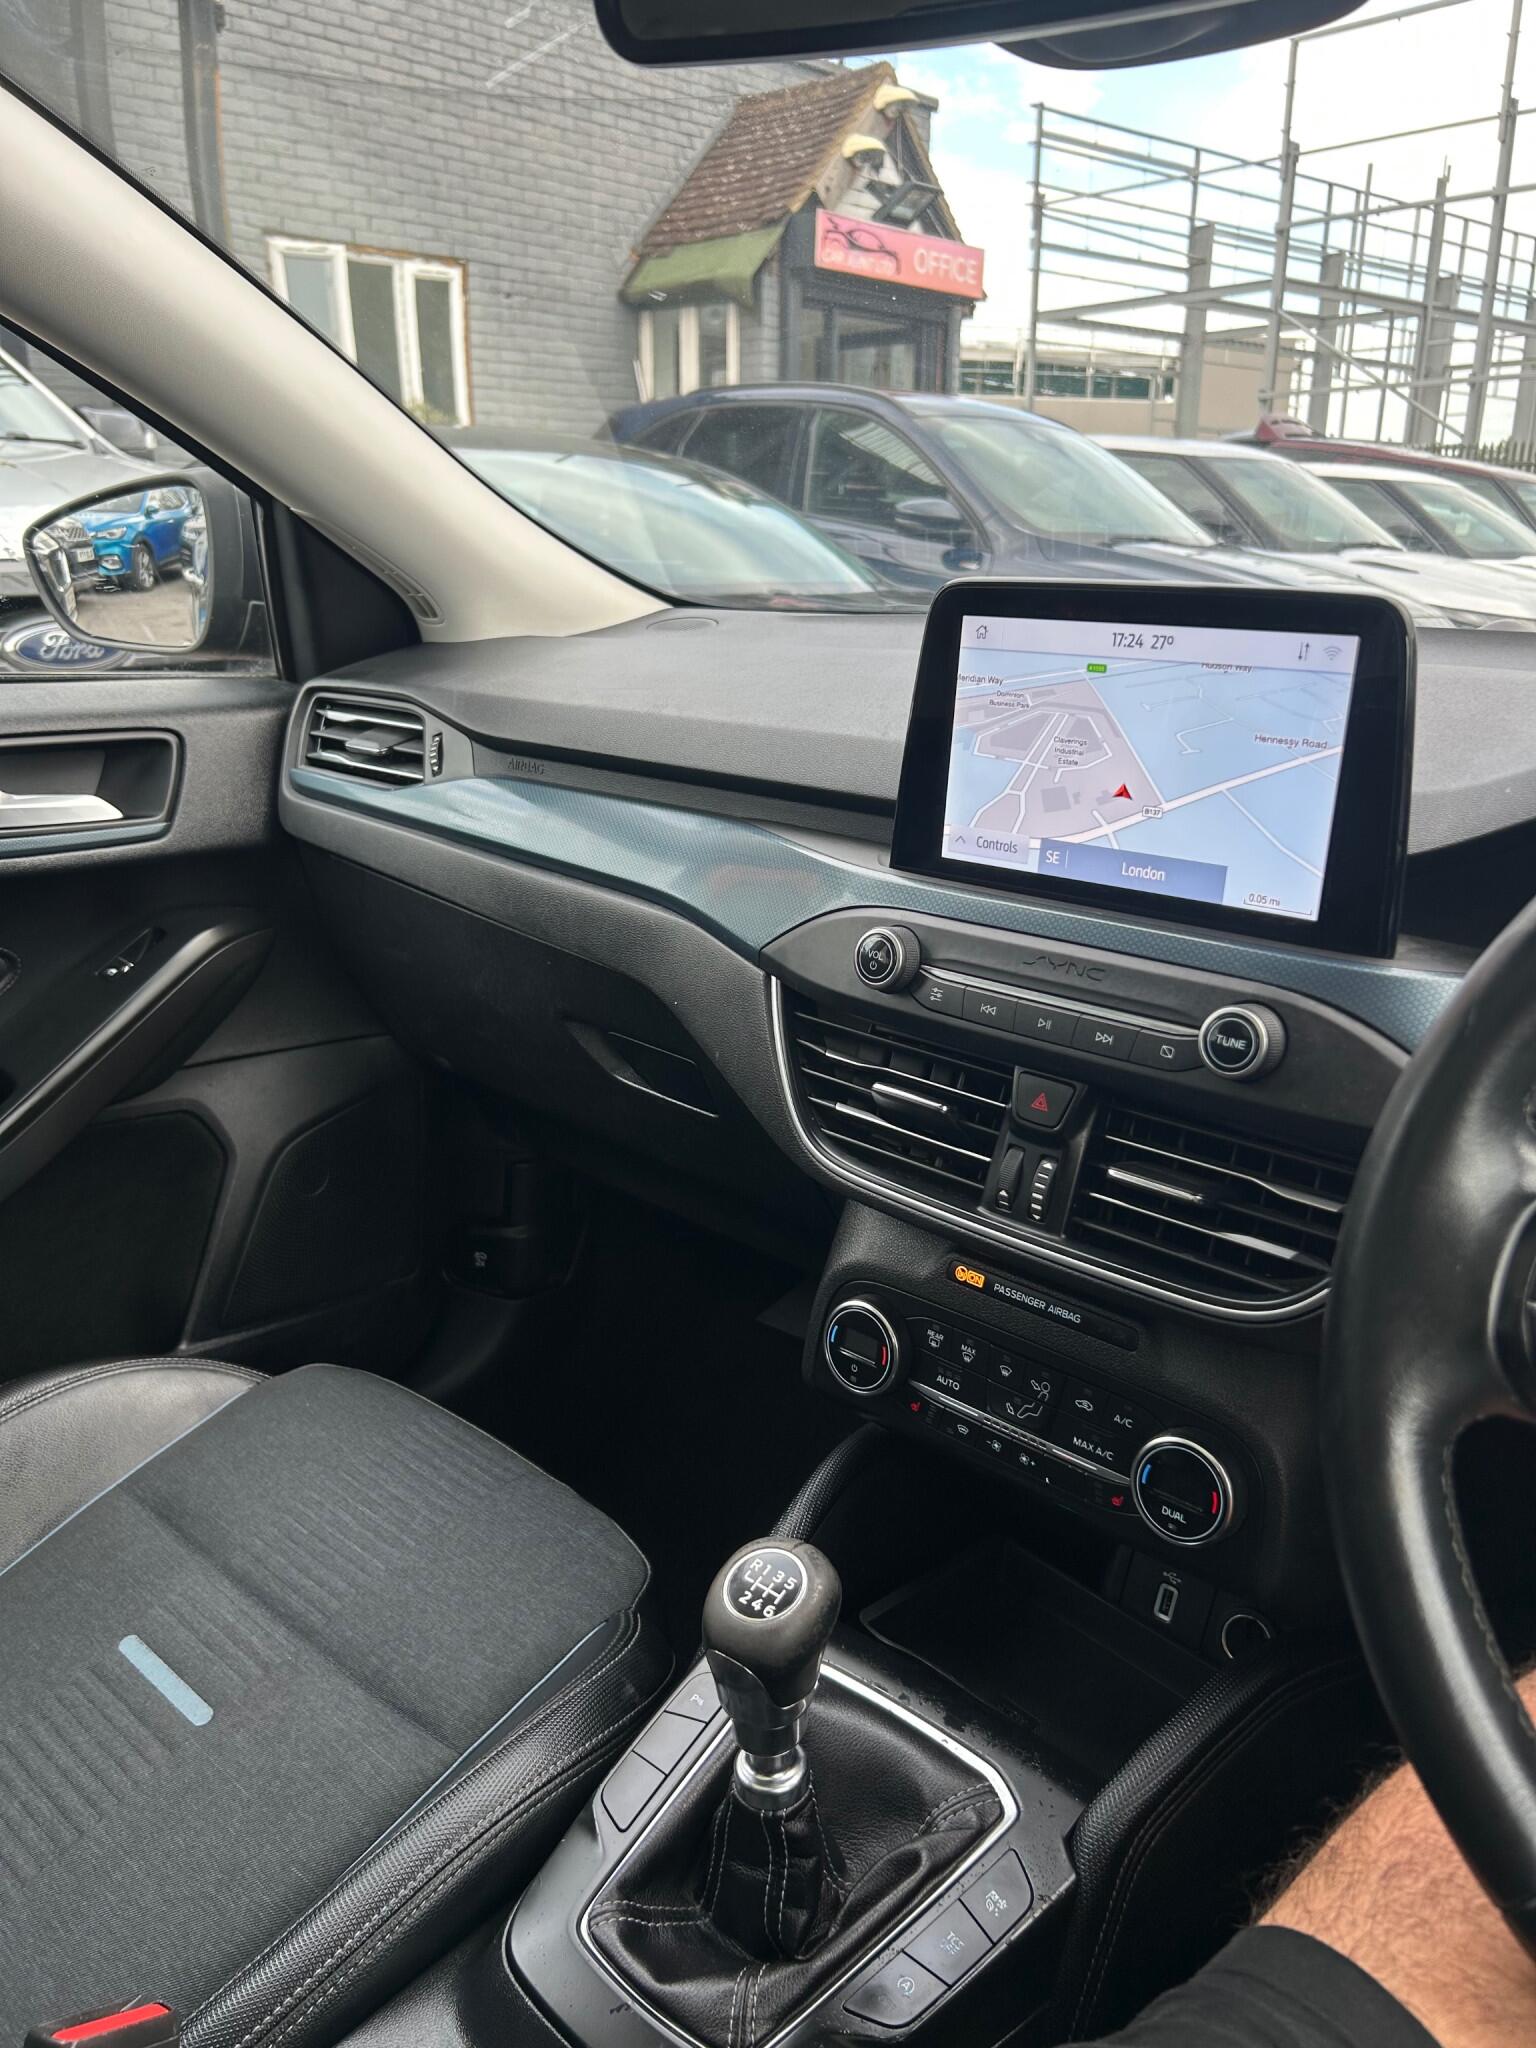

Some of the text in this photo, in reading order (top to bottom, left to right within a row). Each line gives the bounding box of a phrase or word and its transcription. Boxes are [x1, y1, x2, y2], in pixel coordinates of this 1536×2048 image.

[913, 248, 977, 284] OFFICE
[1112, 632, 1144, 649] 17:24
[987, 675, 1004, 686] Way
[989, 699, 1030, 709] Business Park
[1254, 734, 1328, 749] Hennessy Road
[1054, 747, 1085, 757] Industrial
[1058, 757, 1079, 766] Estate
[976, 836, 1018, 854] Controls
[1045, 850, 1060, 865] SE
[1122, 862, 1165, 882] London
[1248, 893, 1280, 907] 0.05 mi
[868, 949, 883, 961] VOL
[1022, 955, 1106, 982] SYNC
[1216, 1034, 1247, 1051] TUNE
[994, 1283, 1081, 1324] PASSENGER AIRBAG
[927, 1328, 945, 1341] REAR
[961, 1344, 977, 1355] MAX
[936, 1375, 960, 1391] AUTO
[1113, 1414, 1134, 1429] A/C
[1073, 1436, 1115, 1461] MAX A/C
[1161, 1505, 1187, 1524] DUAL
[749, 1558, 798, 1590] R 1 3 5
[738, 1590, 776, 1618] 2 4 6
